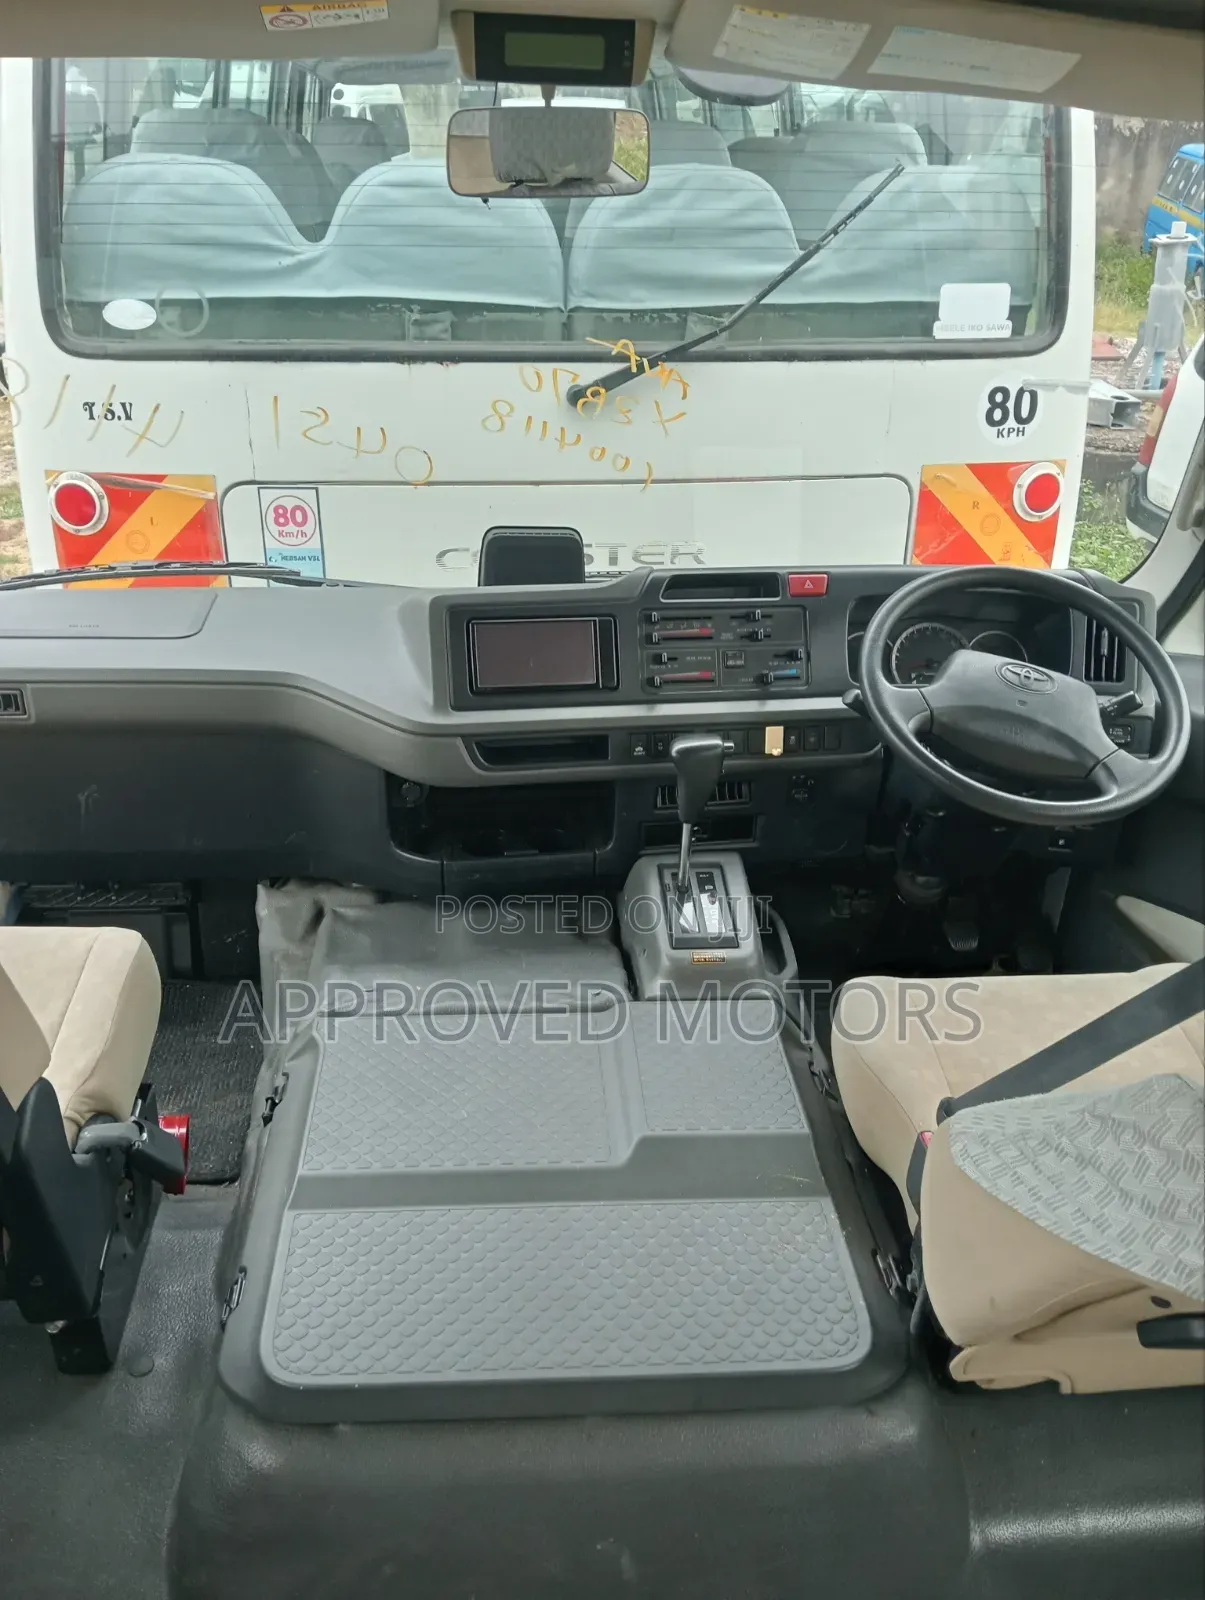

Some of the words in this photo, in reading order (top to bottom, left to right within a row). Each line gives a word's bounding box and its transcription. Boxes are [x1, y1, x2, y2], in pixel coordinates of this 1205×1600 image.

[985, 322, 1011, 333] SAWA
[985, 385, 1039, 428] 80
[996, 426, 1026, 439] KPH
[972, 500, 980, 510] R
[273, 504, 308, 527] 80
[278, 529, 307, 539] Km/h
